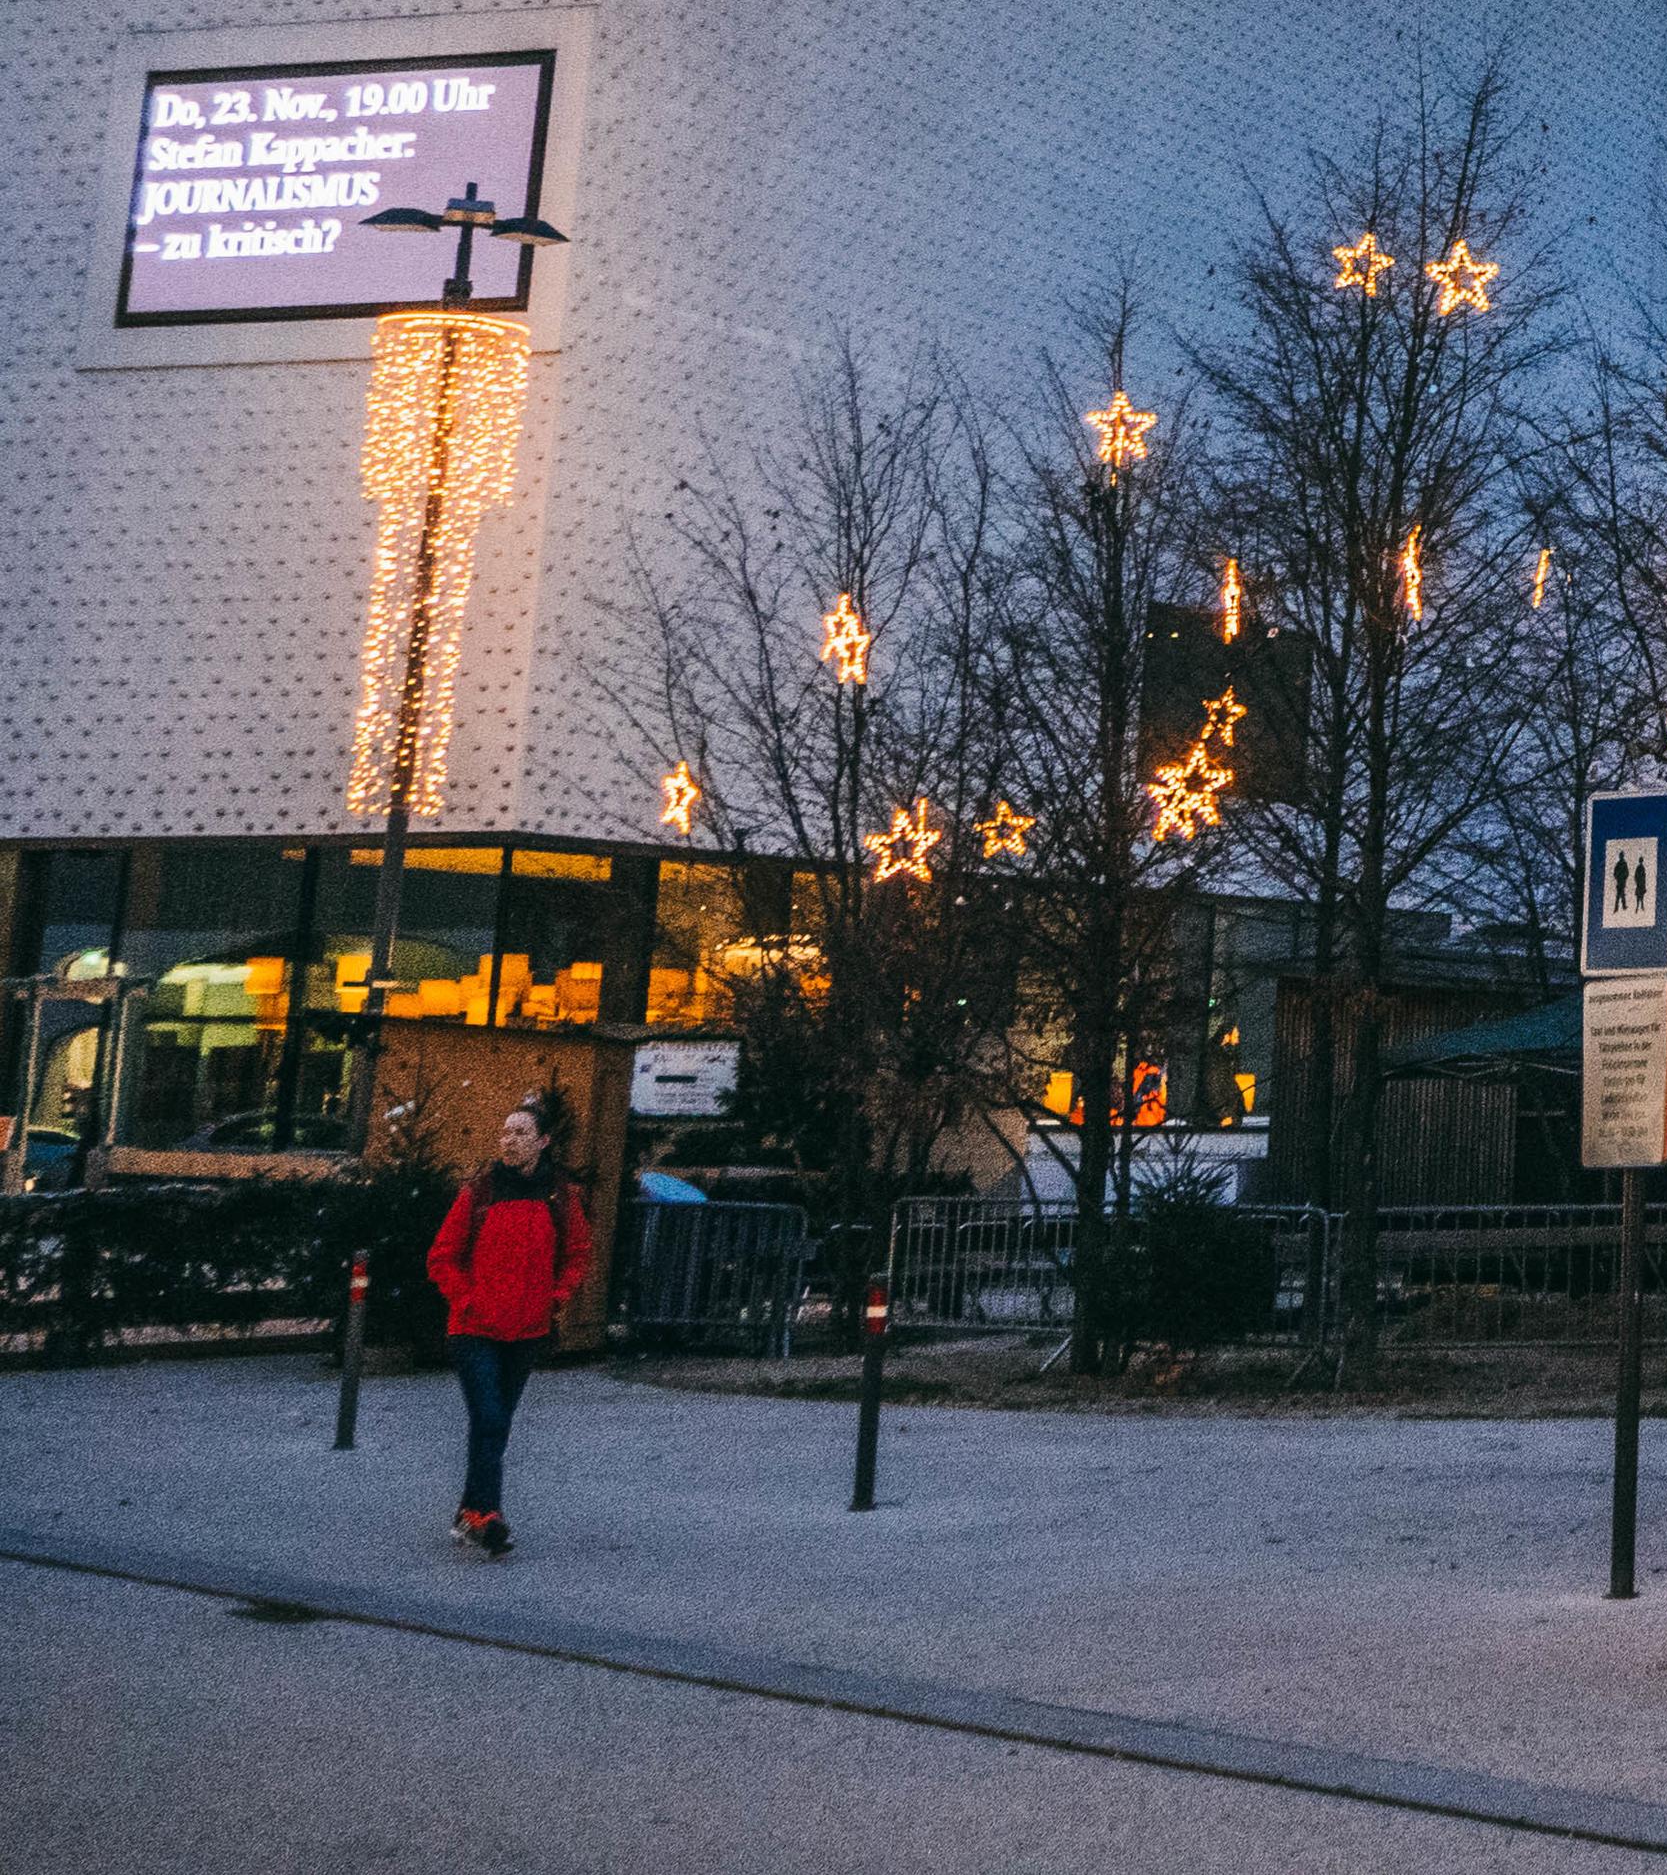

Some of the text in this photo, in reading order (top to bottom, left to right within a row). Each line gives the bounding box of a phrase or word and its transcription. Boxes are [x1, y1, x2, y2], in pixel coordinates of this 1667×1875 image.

[153, 94, 206, 130] Do,
[210, 90, 258, 125] 23.
[345, 82, 428, 115] 19.00
[432, 77, 496, 112] Uhr
[148, 134, 244, 171] Stefan
[136, 172, 381, 225] JOURNALISMUS
[161, 233, 202, 260] zu
[206, 218, 342, 259] kritisch?
